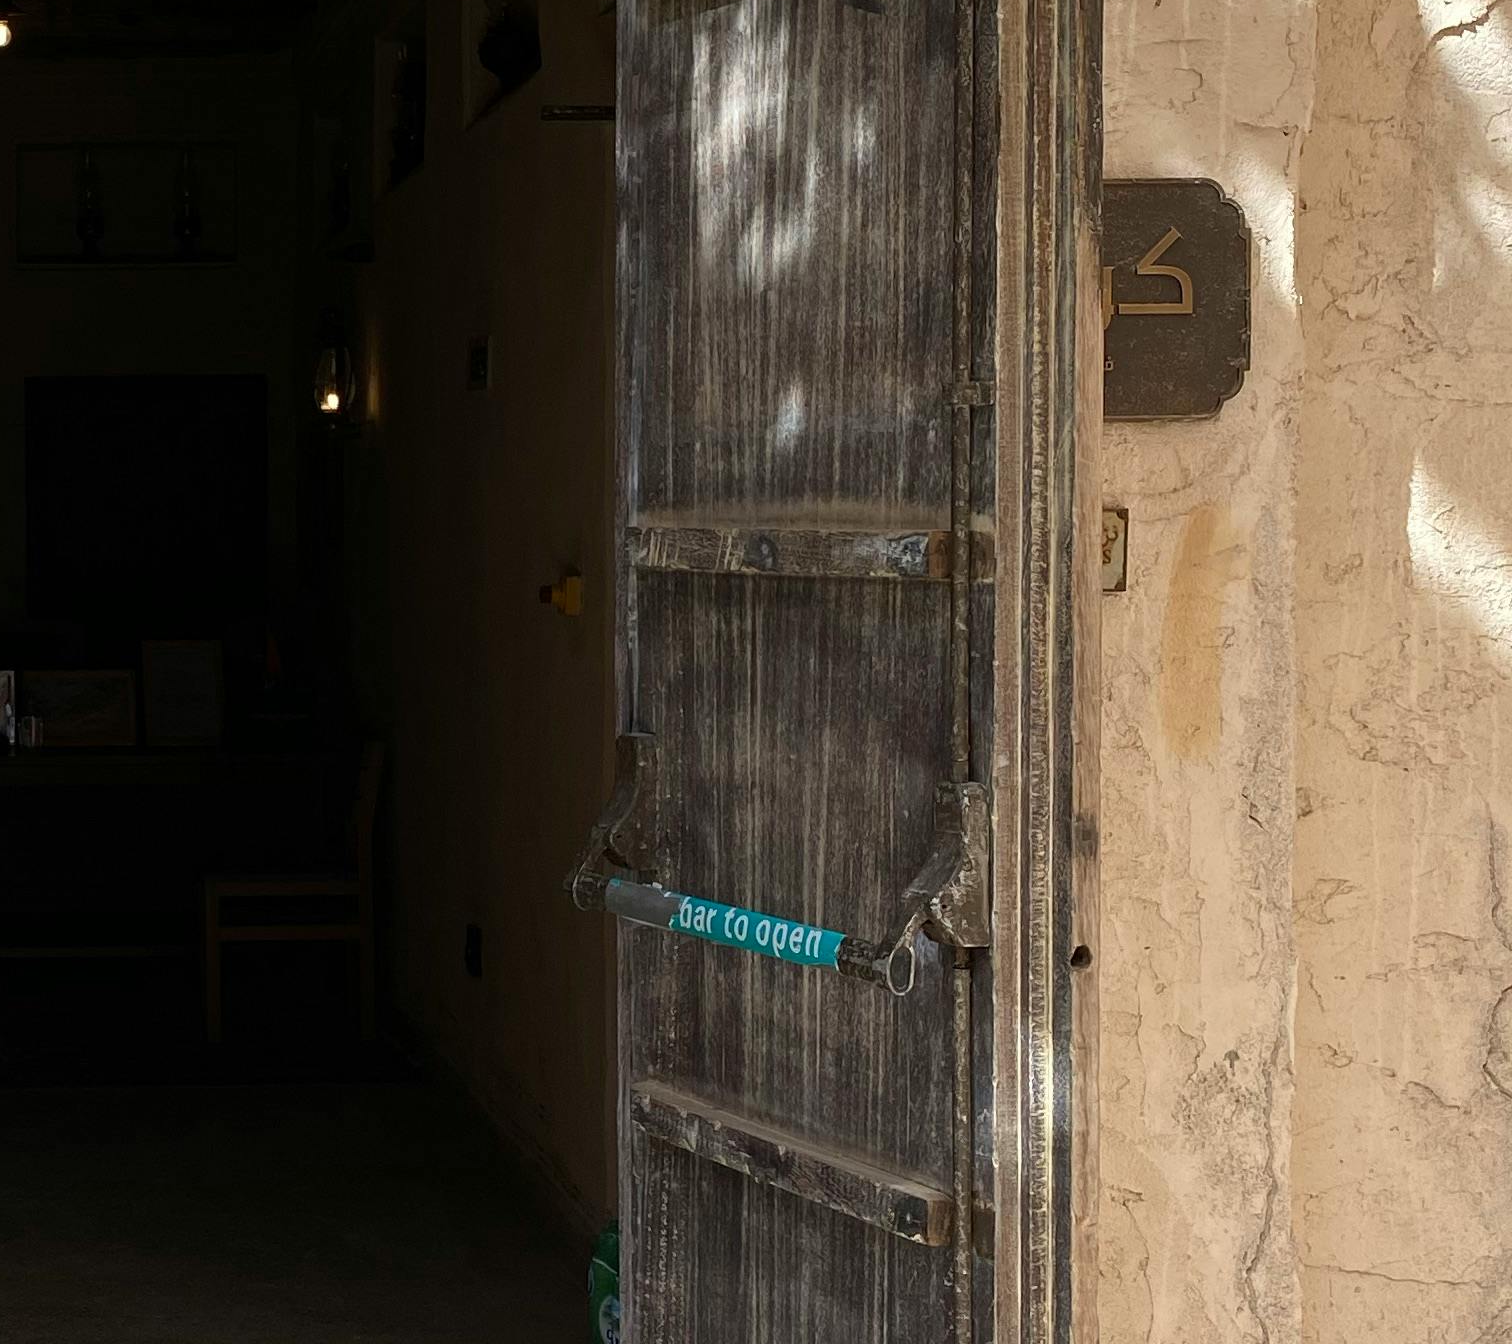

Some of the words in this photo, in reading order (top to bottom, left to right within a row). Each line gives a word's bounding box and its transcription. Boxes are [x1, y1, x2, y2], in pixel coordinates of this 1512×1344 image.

[678, 895, 718, 934] bar
[723, 906, 750, 942] to
[755, 916, 824, 959] open
